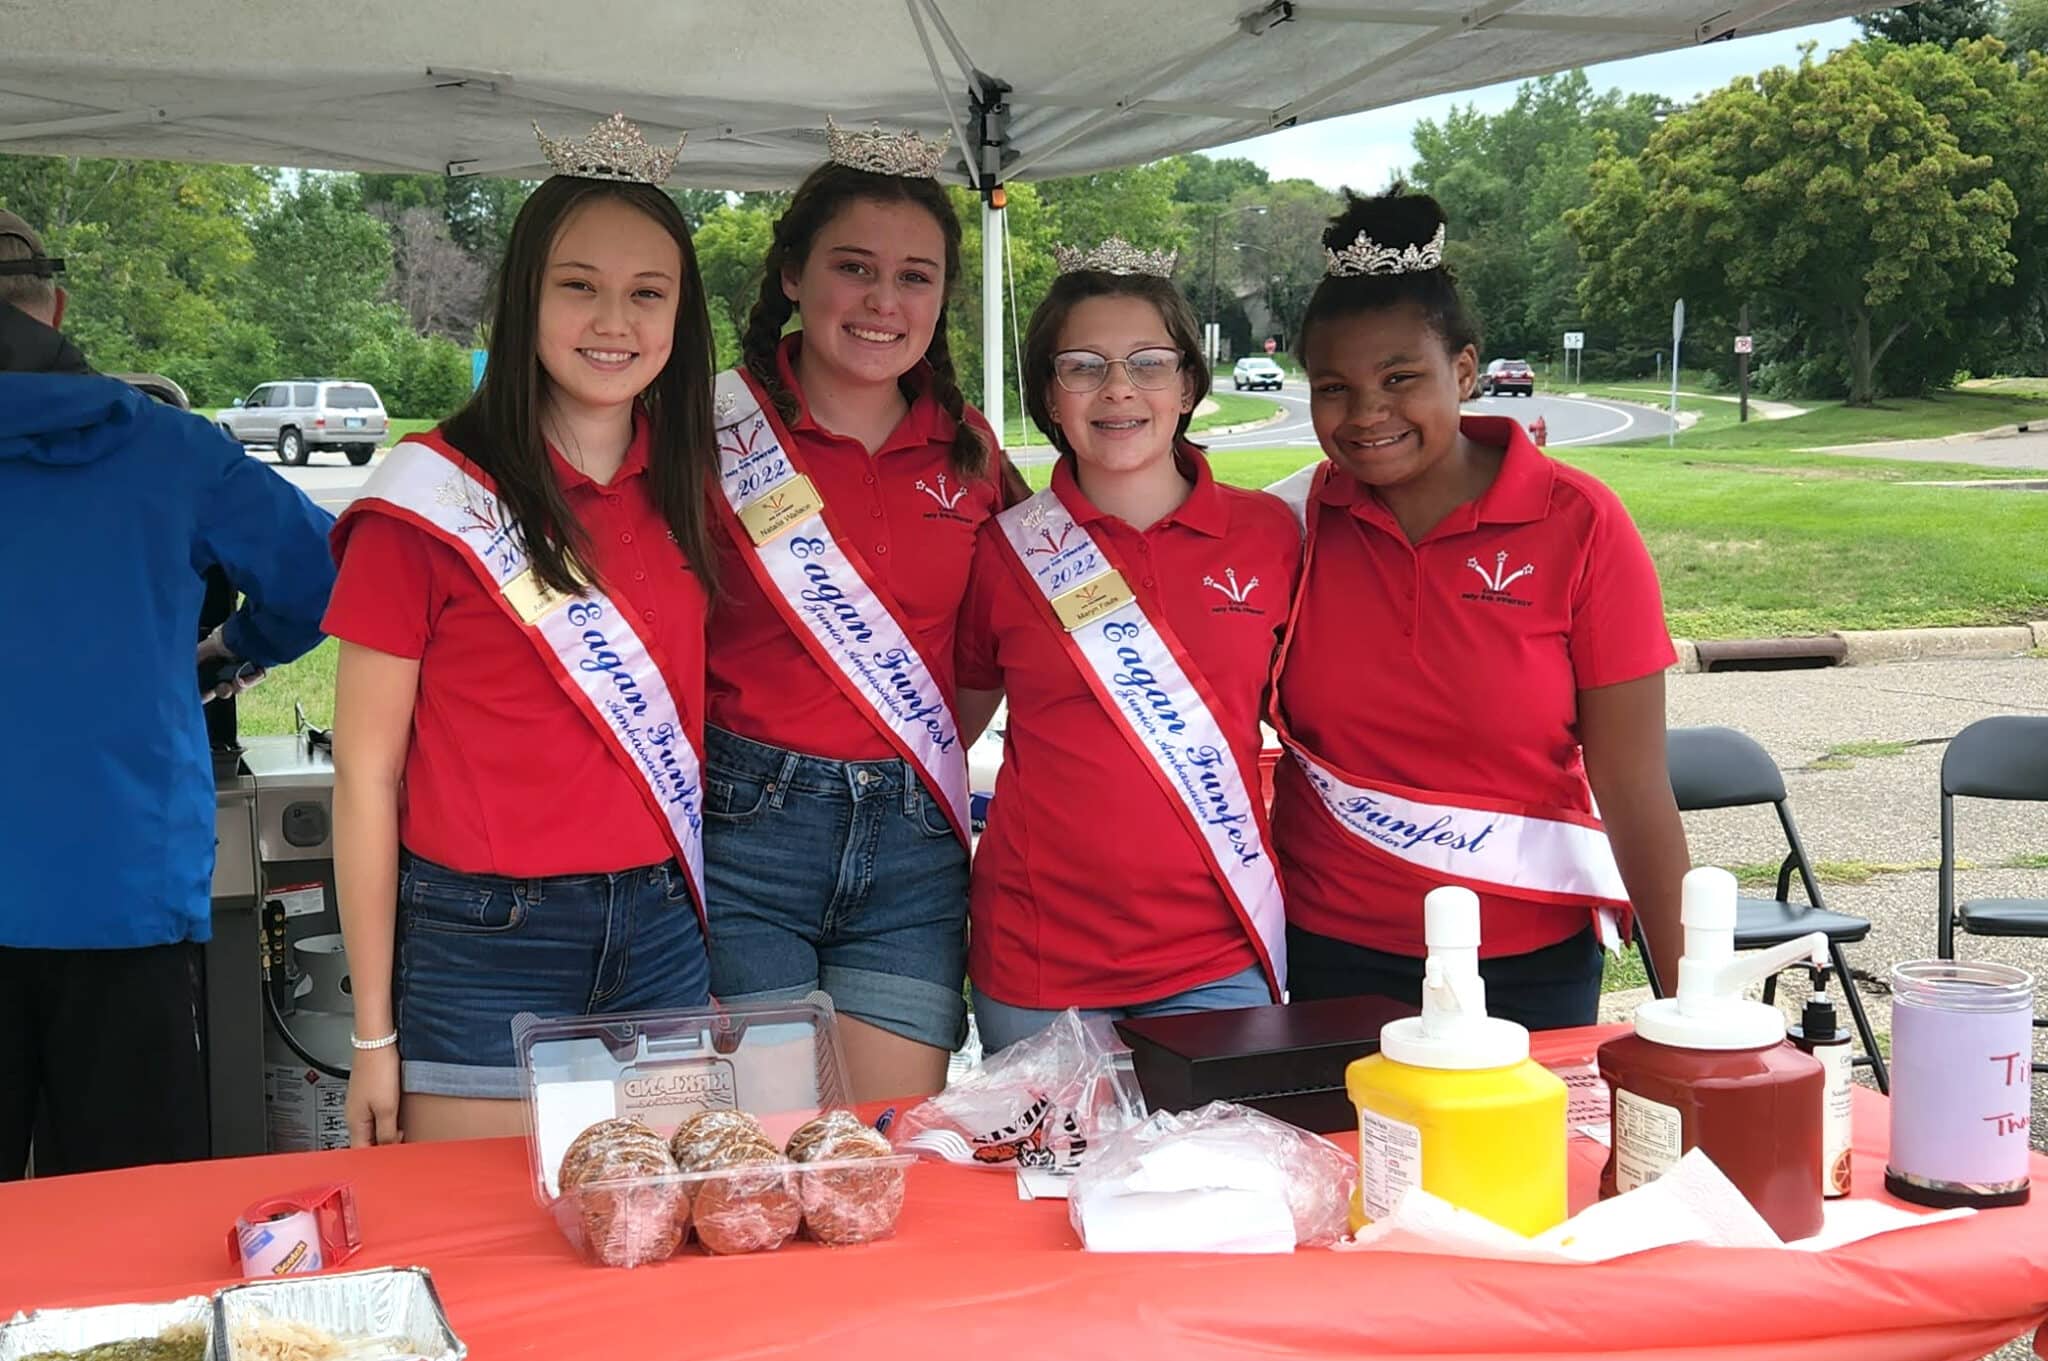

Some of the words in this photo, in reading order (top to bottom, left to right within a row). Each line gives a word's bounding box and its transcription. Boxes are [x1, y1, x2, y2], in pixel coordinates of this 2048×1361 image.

[738, 458, 786, 500] 2022
[499, 544, 521, 577] 20
[1051, 553, 1097, 593] 2022
[790, 536, 874, 644] Eagan
[872, 648, 956, 754] Funfest
[803, 603, 845, 646] Junior
[844, 648, 904, 718] Ambassador
[568, 602, 648, 717] Eagan
[646, 722, 702, 839] Funfest
[605, 699, 668, 796] Ambassador
[1103, 621, 1186, 736] Eagan
[1186, 745, 1261, 868] Funfest
[1115, 688, 1156, 736] Junior
[1155, 738, 1208, 819] Ambassador
[1338, 796, 1493, 853] Funfest
